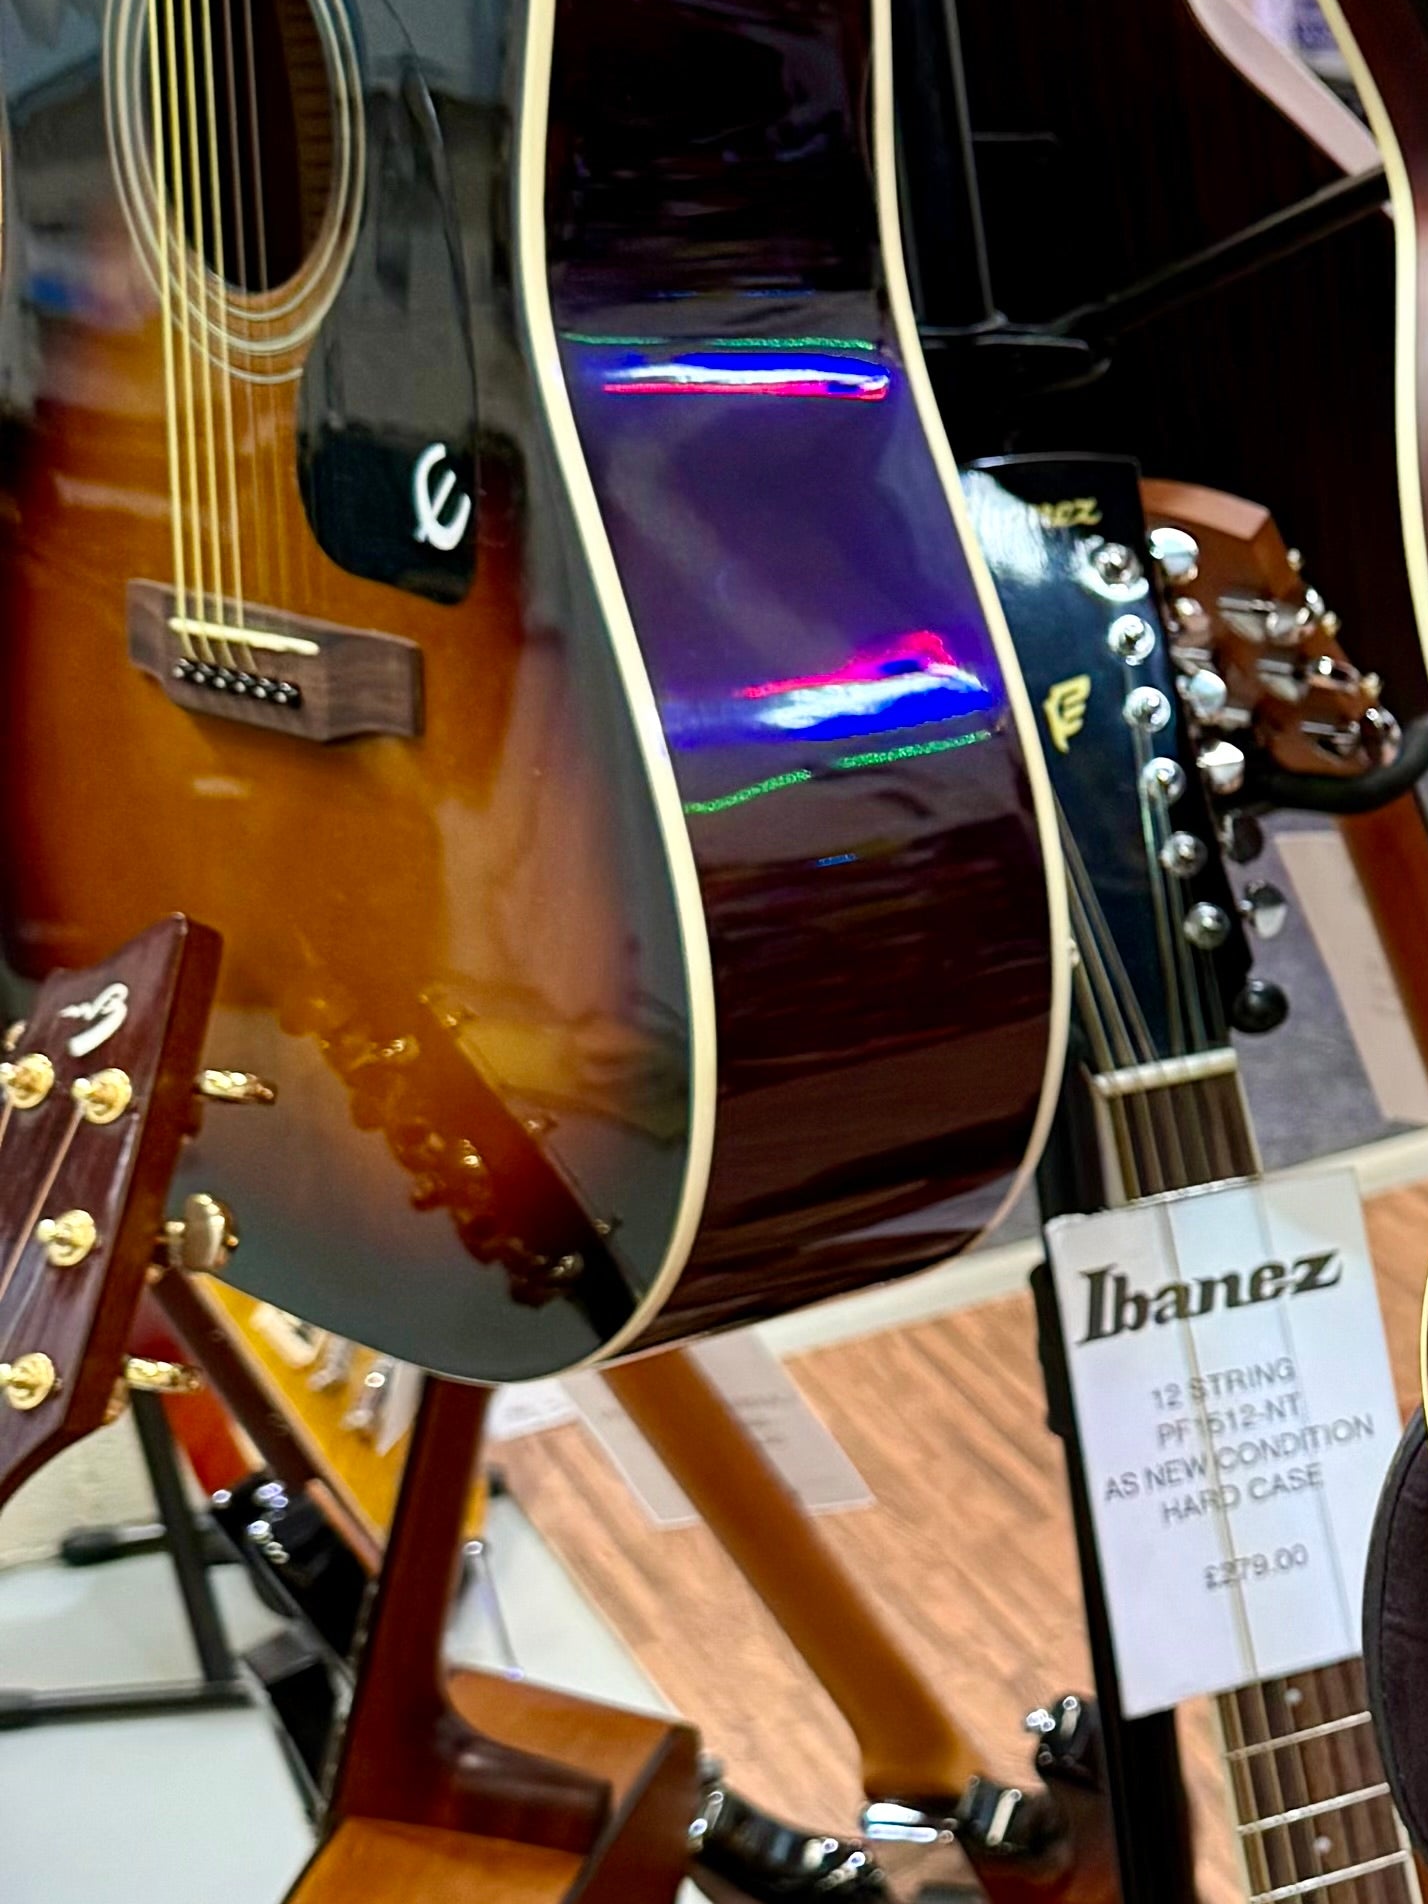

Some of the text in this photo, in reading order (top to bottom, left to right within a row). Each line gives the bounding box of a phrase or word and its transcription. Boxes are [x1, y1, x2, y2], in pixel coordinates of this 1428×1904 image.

[1078, 1248, 1344, 1347] Ibanez
[1152, 1357, 1295, 1410] 12 STRING
[1105, 1413, 1375, 1503] AS NEW CONDITION
[1163, 1461, 1325, 1526] HARD CASE
